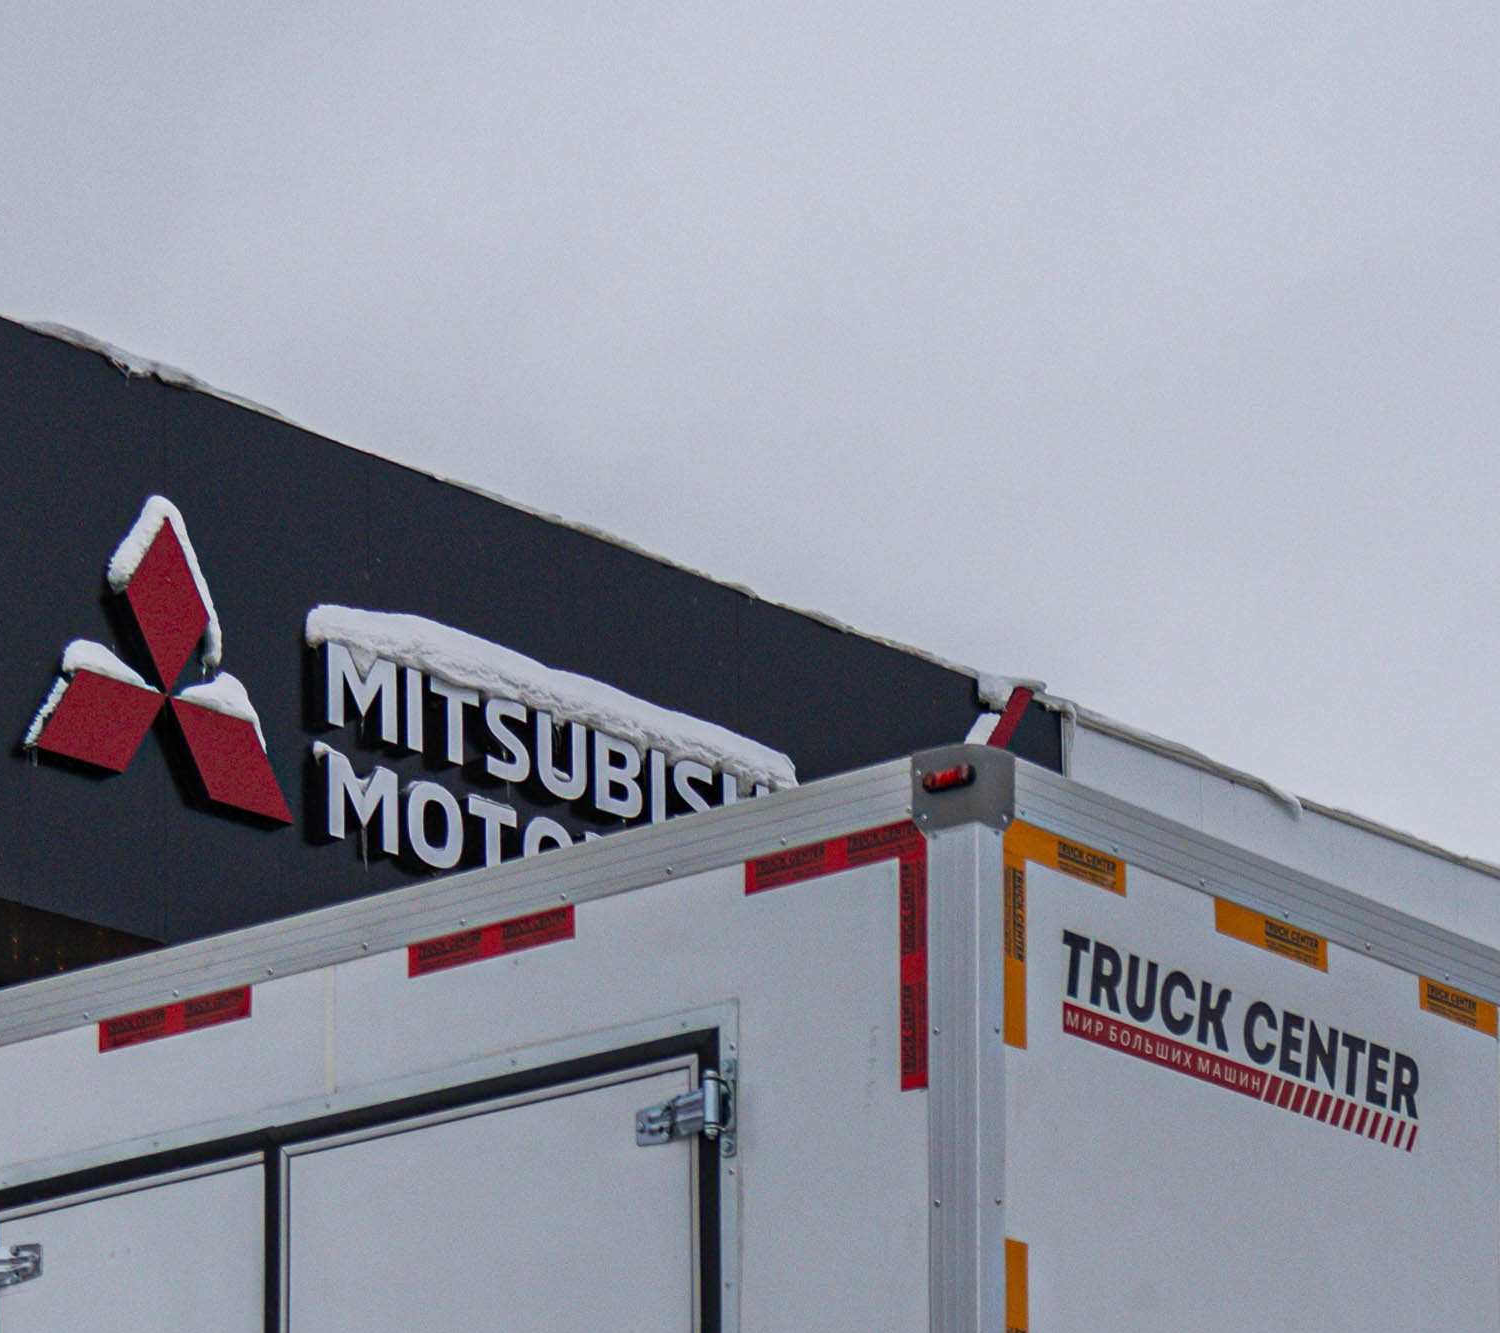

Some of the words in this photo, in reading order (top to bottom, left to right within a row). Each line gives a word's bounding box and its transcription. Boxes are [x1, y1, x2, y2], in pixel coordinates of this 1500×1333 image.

[326, 640, 770, 820] MITSUBIS
[1063, 929, 1232, 1053] TRUCK
[1243, 1001, 1419, 1120] CENTER
[1065, 1009, 1104, 1037] МИР
[1108, 1025, 1193, 1070] БОЛЬШИХ
[1197, 1056, 1262, 1092] МАШИН
